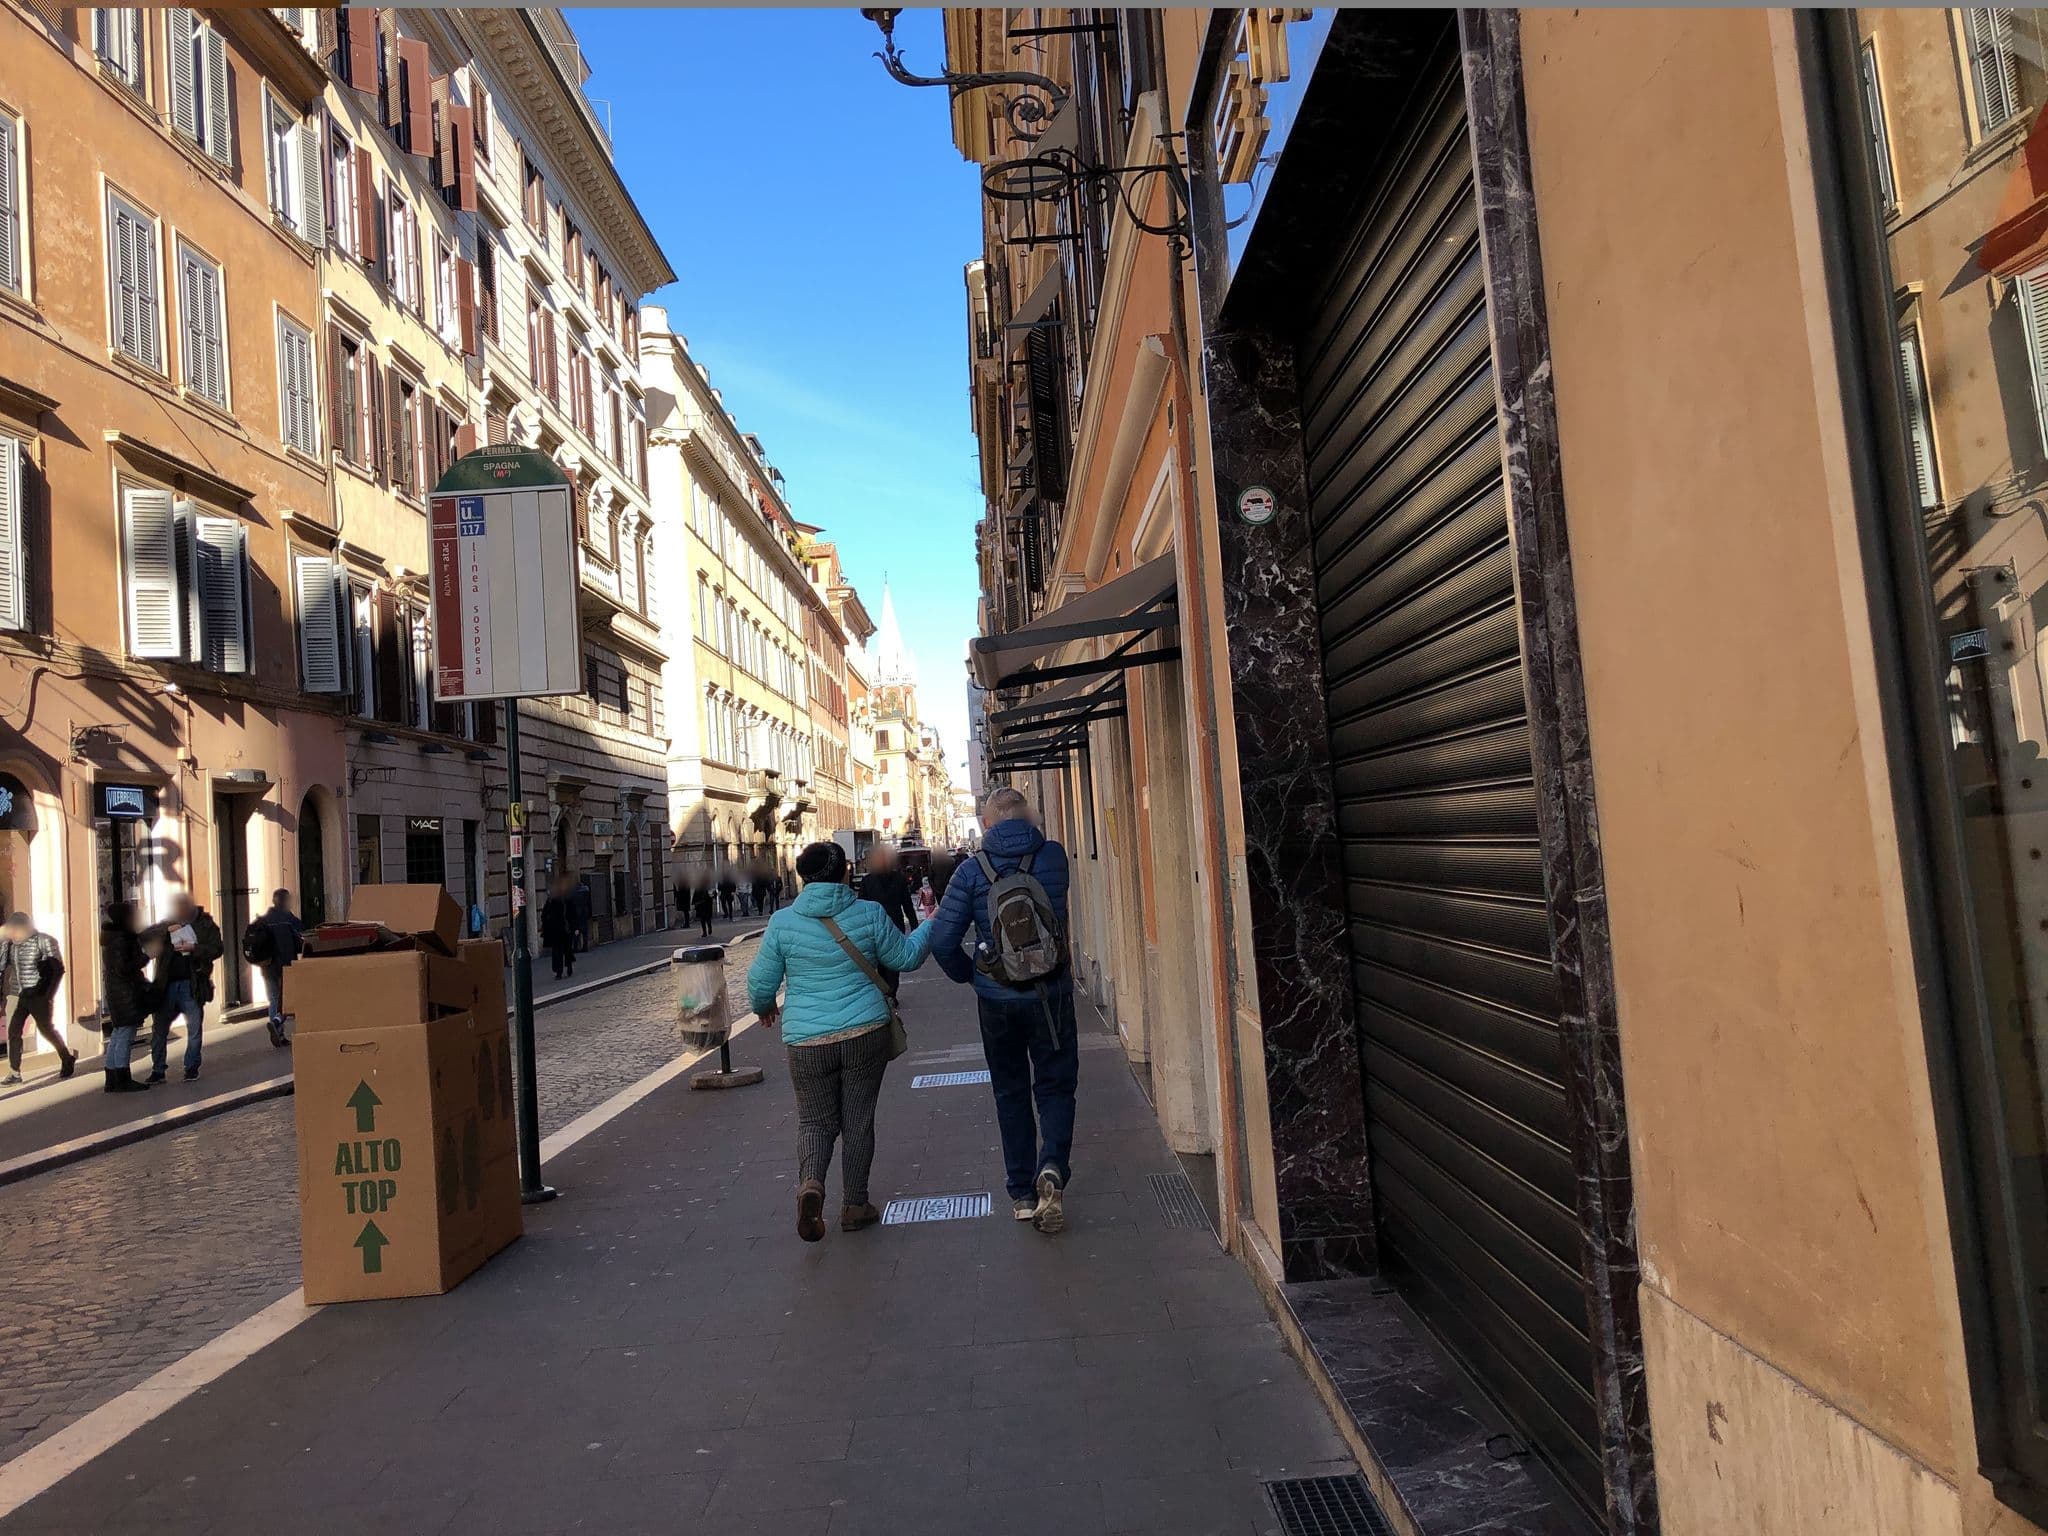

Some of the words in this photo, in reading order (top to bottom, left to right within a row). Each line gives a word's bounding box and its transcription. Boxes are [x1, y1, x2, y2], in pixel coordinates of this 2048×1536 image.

[481, 446, 522, 456] FERMATA
[483, 461, 521, 471] SPAGNA
[462, 524, 480, 535] 117
[442, 543, 450, 562] atac
[473, 605, 482, 675] sospesa
[411, 819, 440, 830] MAC
[335, 1138, 401, 1176] ALTO
[342, 1179, 397, 1214] TOP
